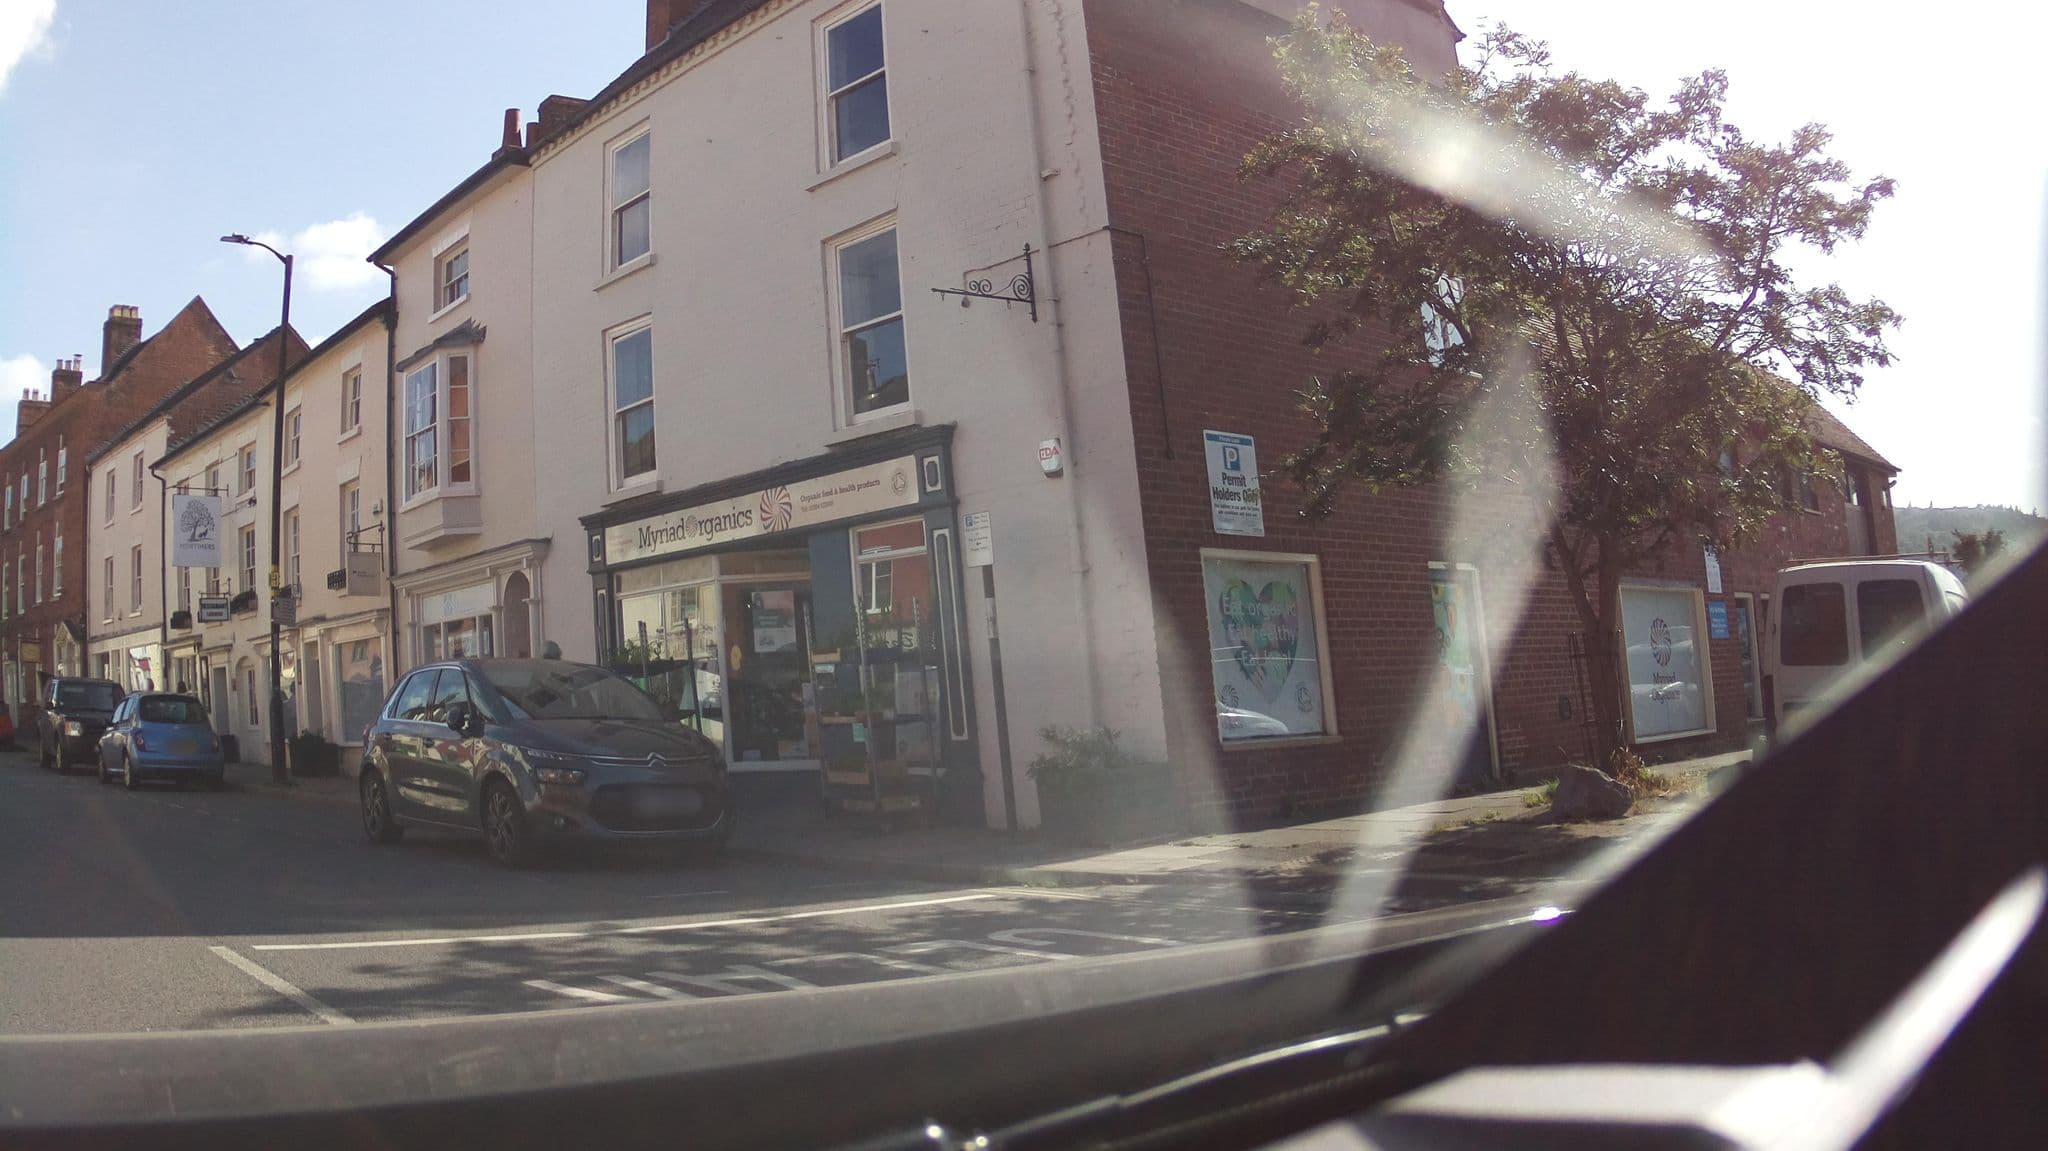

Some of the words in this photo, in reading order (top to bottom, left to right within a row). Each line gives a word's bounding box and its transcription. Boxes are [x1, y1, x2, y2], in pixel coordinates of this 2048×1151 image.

[857, 479, 880, 491] products
[1221, 472, 1247, 488] Permit
[1212, 486, 1241, 502] Holders
